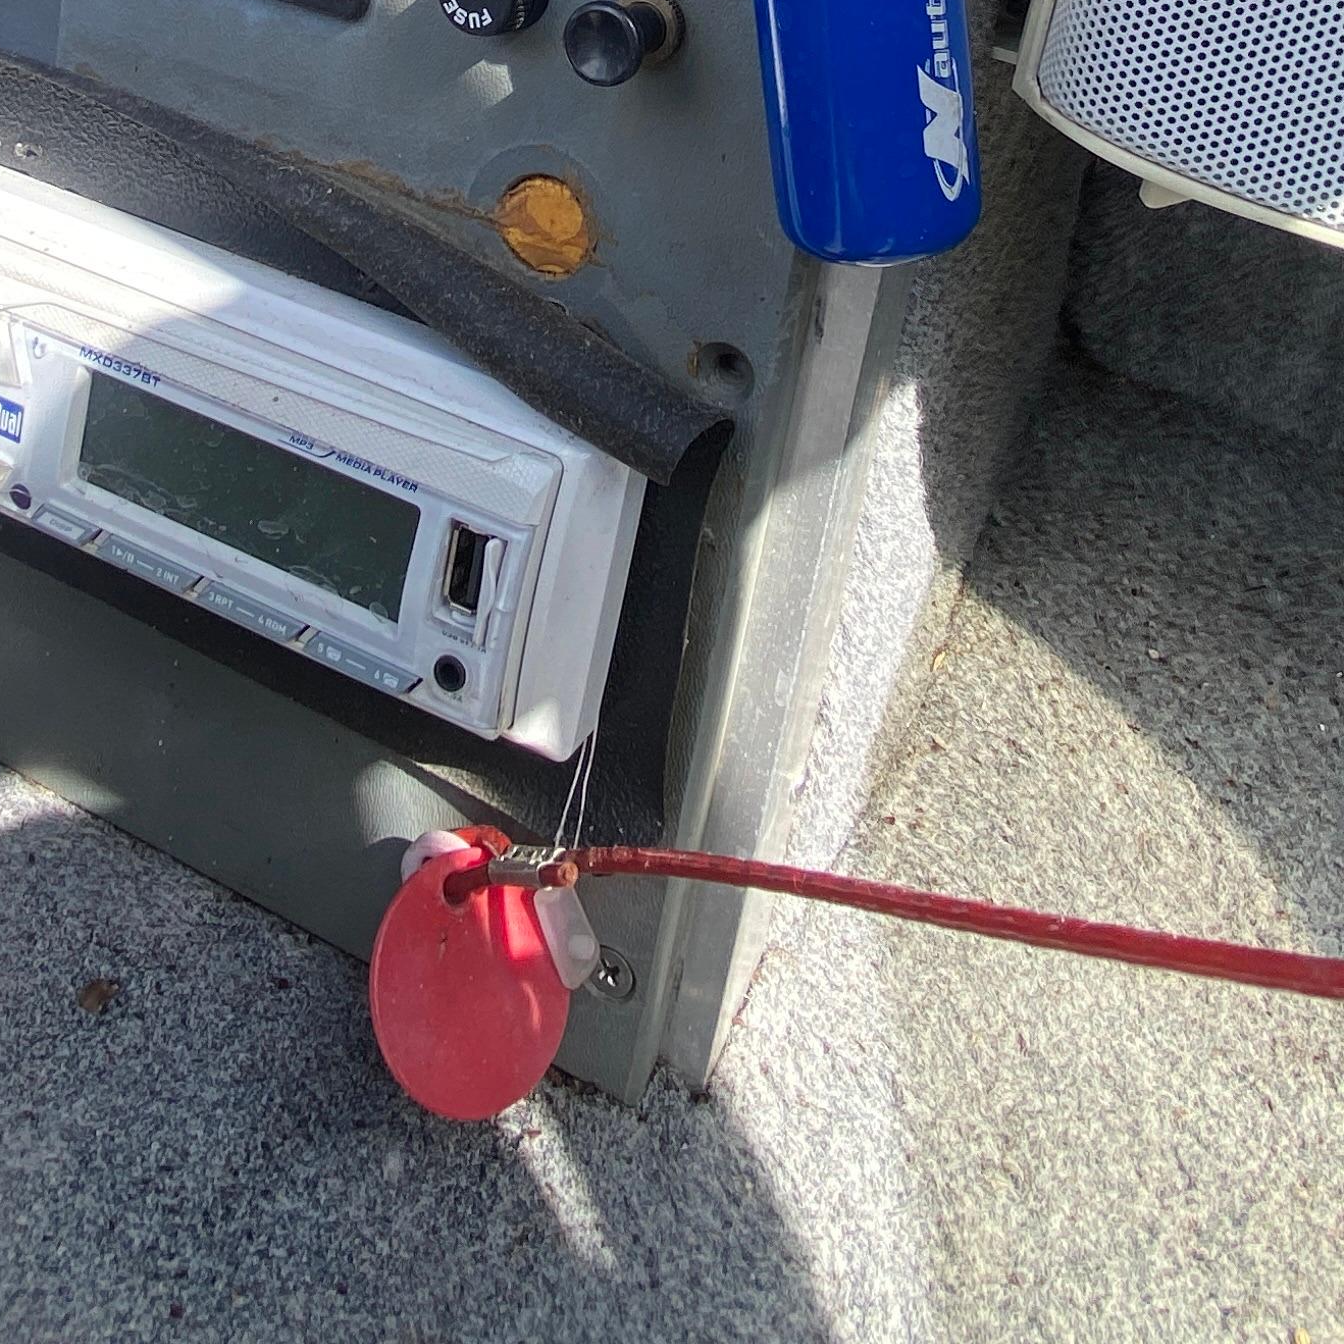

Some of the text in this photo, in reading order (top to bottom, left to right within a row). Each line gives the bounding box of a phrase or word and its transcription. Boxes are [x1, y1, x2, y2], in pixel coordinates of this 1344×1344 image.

[79, 346, 161, 388] MXD337BT
[289, 435, 419, 494] MP3 MEDIA PLAYER
[163, 570, 181, 586] INT
[215, 594, 235, 609] RPT
